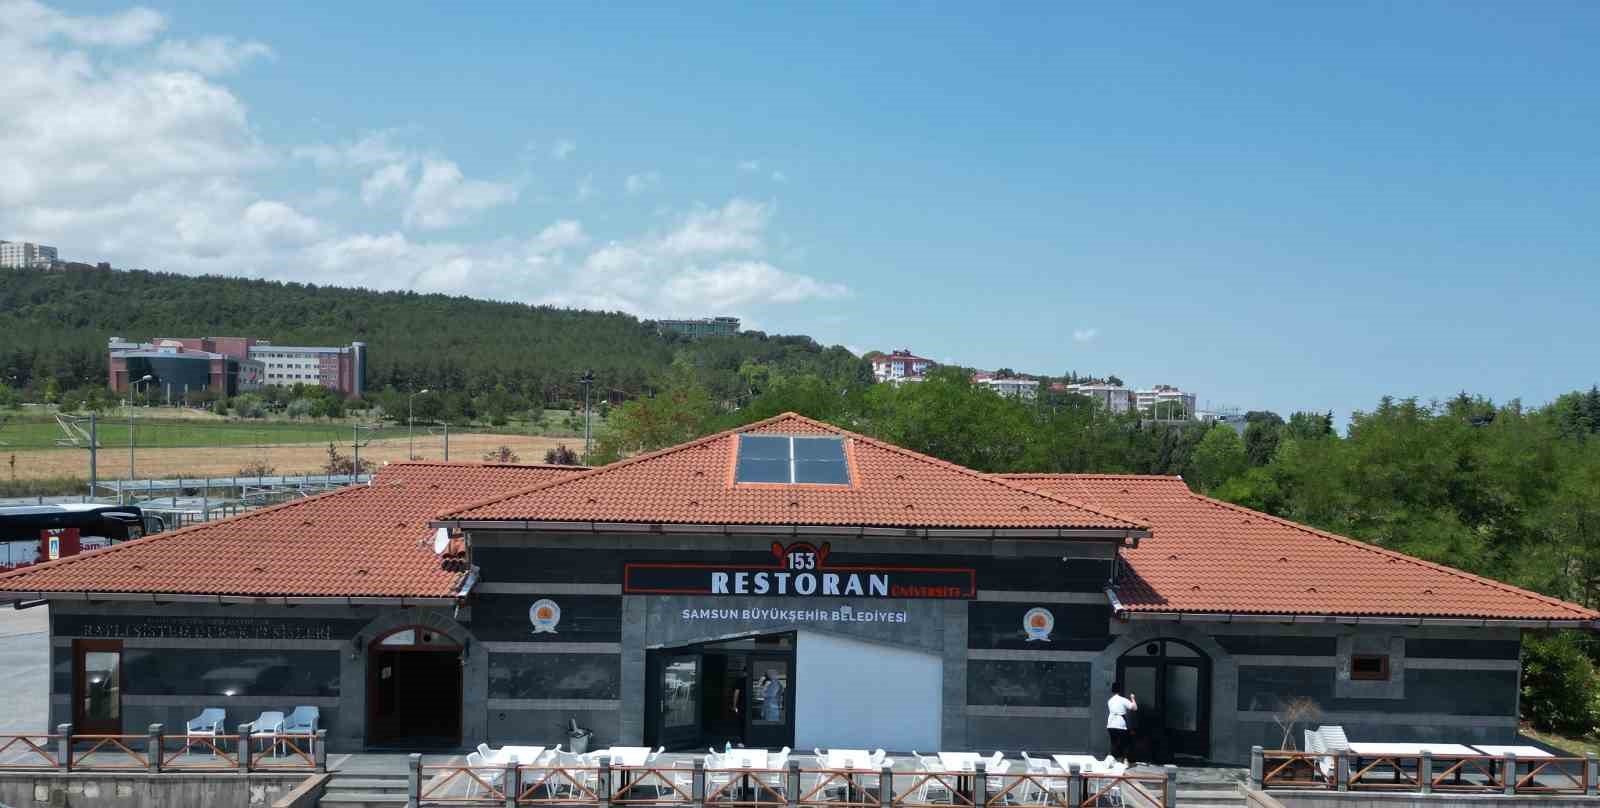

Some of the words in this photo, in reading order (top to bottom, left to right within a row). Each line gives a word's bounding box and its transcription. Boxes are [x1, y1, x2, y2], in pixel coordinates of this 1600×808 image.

[787, 552, 815, 570] 153
[711, 572, 889, 596] RESTORAN
[682, 608, 739, 620] SAMSUN
[742, 607, 828, 623] BÜYÜKŞEHİR
[831, 609, 907, 623] BELEDİYESİ
